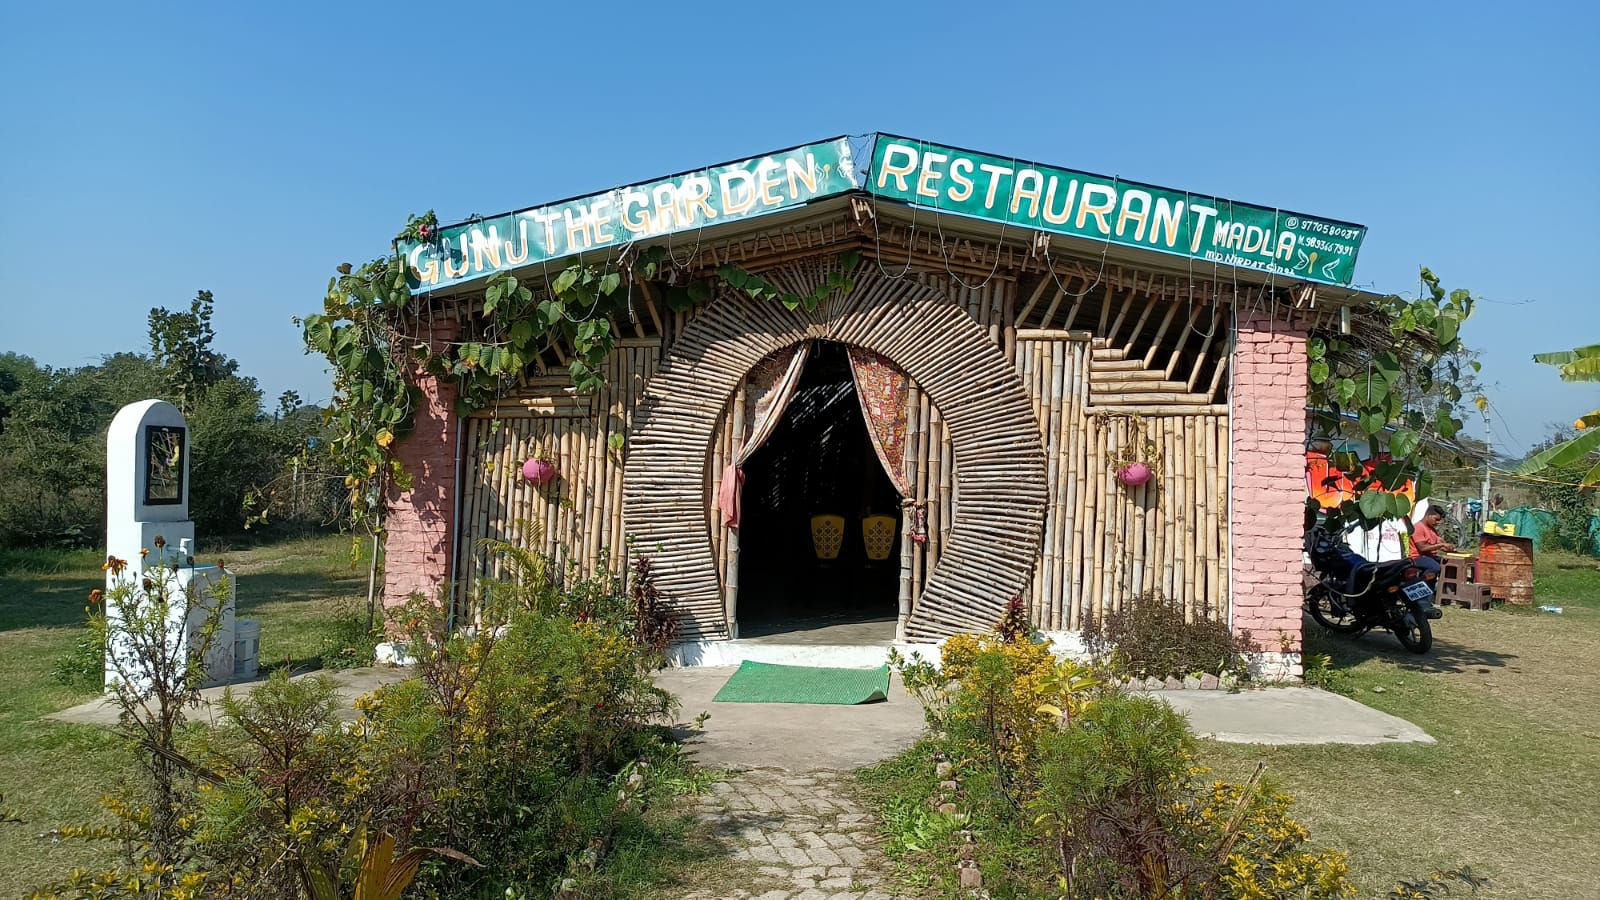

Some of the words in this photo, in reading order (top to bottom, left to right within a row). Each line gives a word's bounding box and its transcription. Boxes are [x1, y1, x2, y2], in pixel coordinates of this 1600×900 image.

[410, 218, 528, 284] GUNJ
[533, 198, 613, 255] THE
[621, 153, 818, 234] GARDEN
[877, 143, 1218, 253] RESTAURANT
[1212, 219, 1297, 261] MADLA
